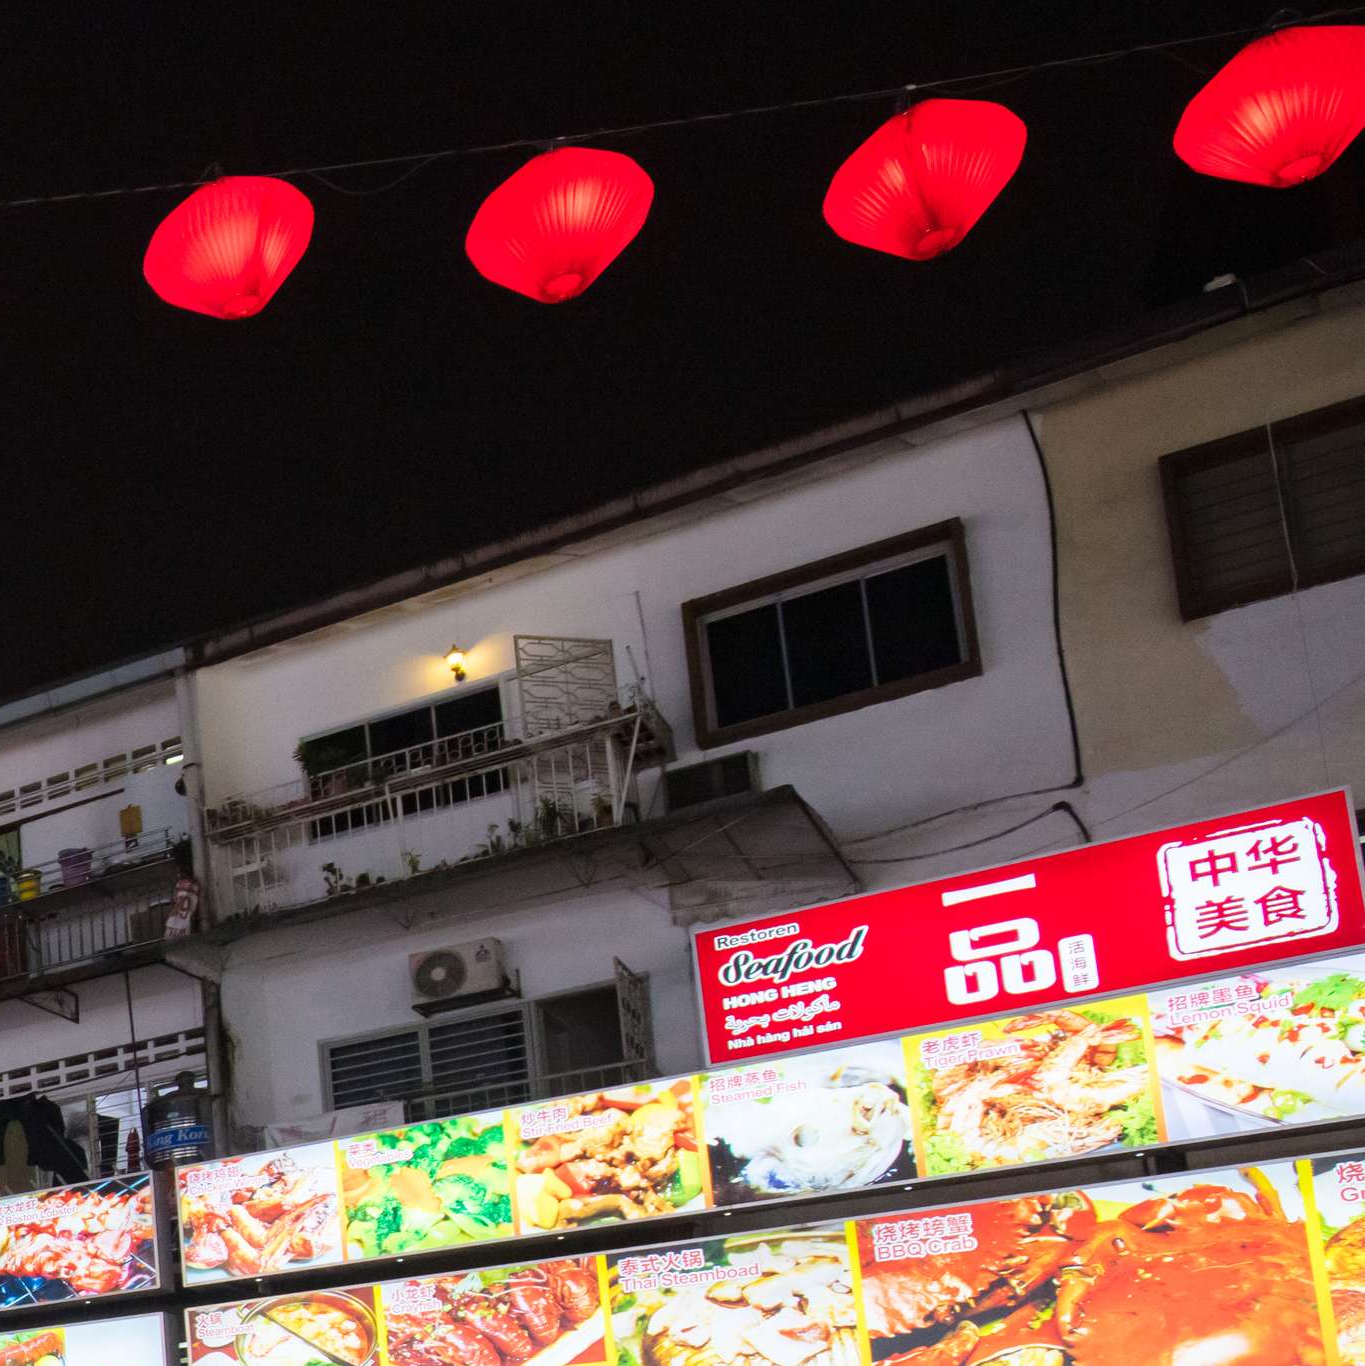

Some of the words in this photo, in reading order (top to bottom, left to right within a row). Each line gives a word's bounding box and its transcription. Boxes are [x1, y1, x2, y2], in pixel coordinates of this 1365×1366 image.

[1189, 832, 1303, 889] 中华
[1194, 884, 1308, 941] 美食
[716, 923, 799, 950] Restoren
[942, 873, 1057, 1006] 一品
[719, 926, 869, 986] Seafood
[723, 986, 779, 1010] HONG
[781, 976, 838, 1000] HENG
[1169, 1006, 1232, 1026] Lemon
[1236, 994, 1292, 1018] Squid
[924, 1049, 967, 1069] Tiger
[967, 1042, 1020, 1060] Prawn
[711, 1083, 774, 1105] Steamed
[775, 1078, 807, 1095] Fish
[521, 1106, 567, 1127] 炒牛肉
[582, 1114, 615, 1131] Beef
[348, 1149, 412, 1169] Vegetables
[5, 1213, 40, 1227] Boston
[874, 1214, 971, 1246] 烧烤螃蟹
[619, 1248, 703, 1276] 泰式火锅
[876, 1239, 926, 1262] BBQ
[929, 1234, 976, 1255] Crab
[621, 1267, 659, 1293] Thai
[661, 1261, 760, 1289] Steamboad
[392, 1298, 443, 1316] Crayfish
[197, 1323, 255, 1340] Steamboat
